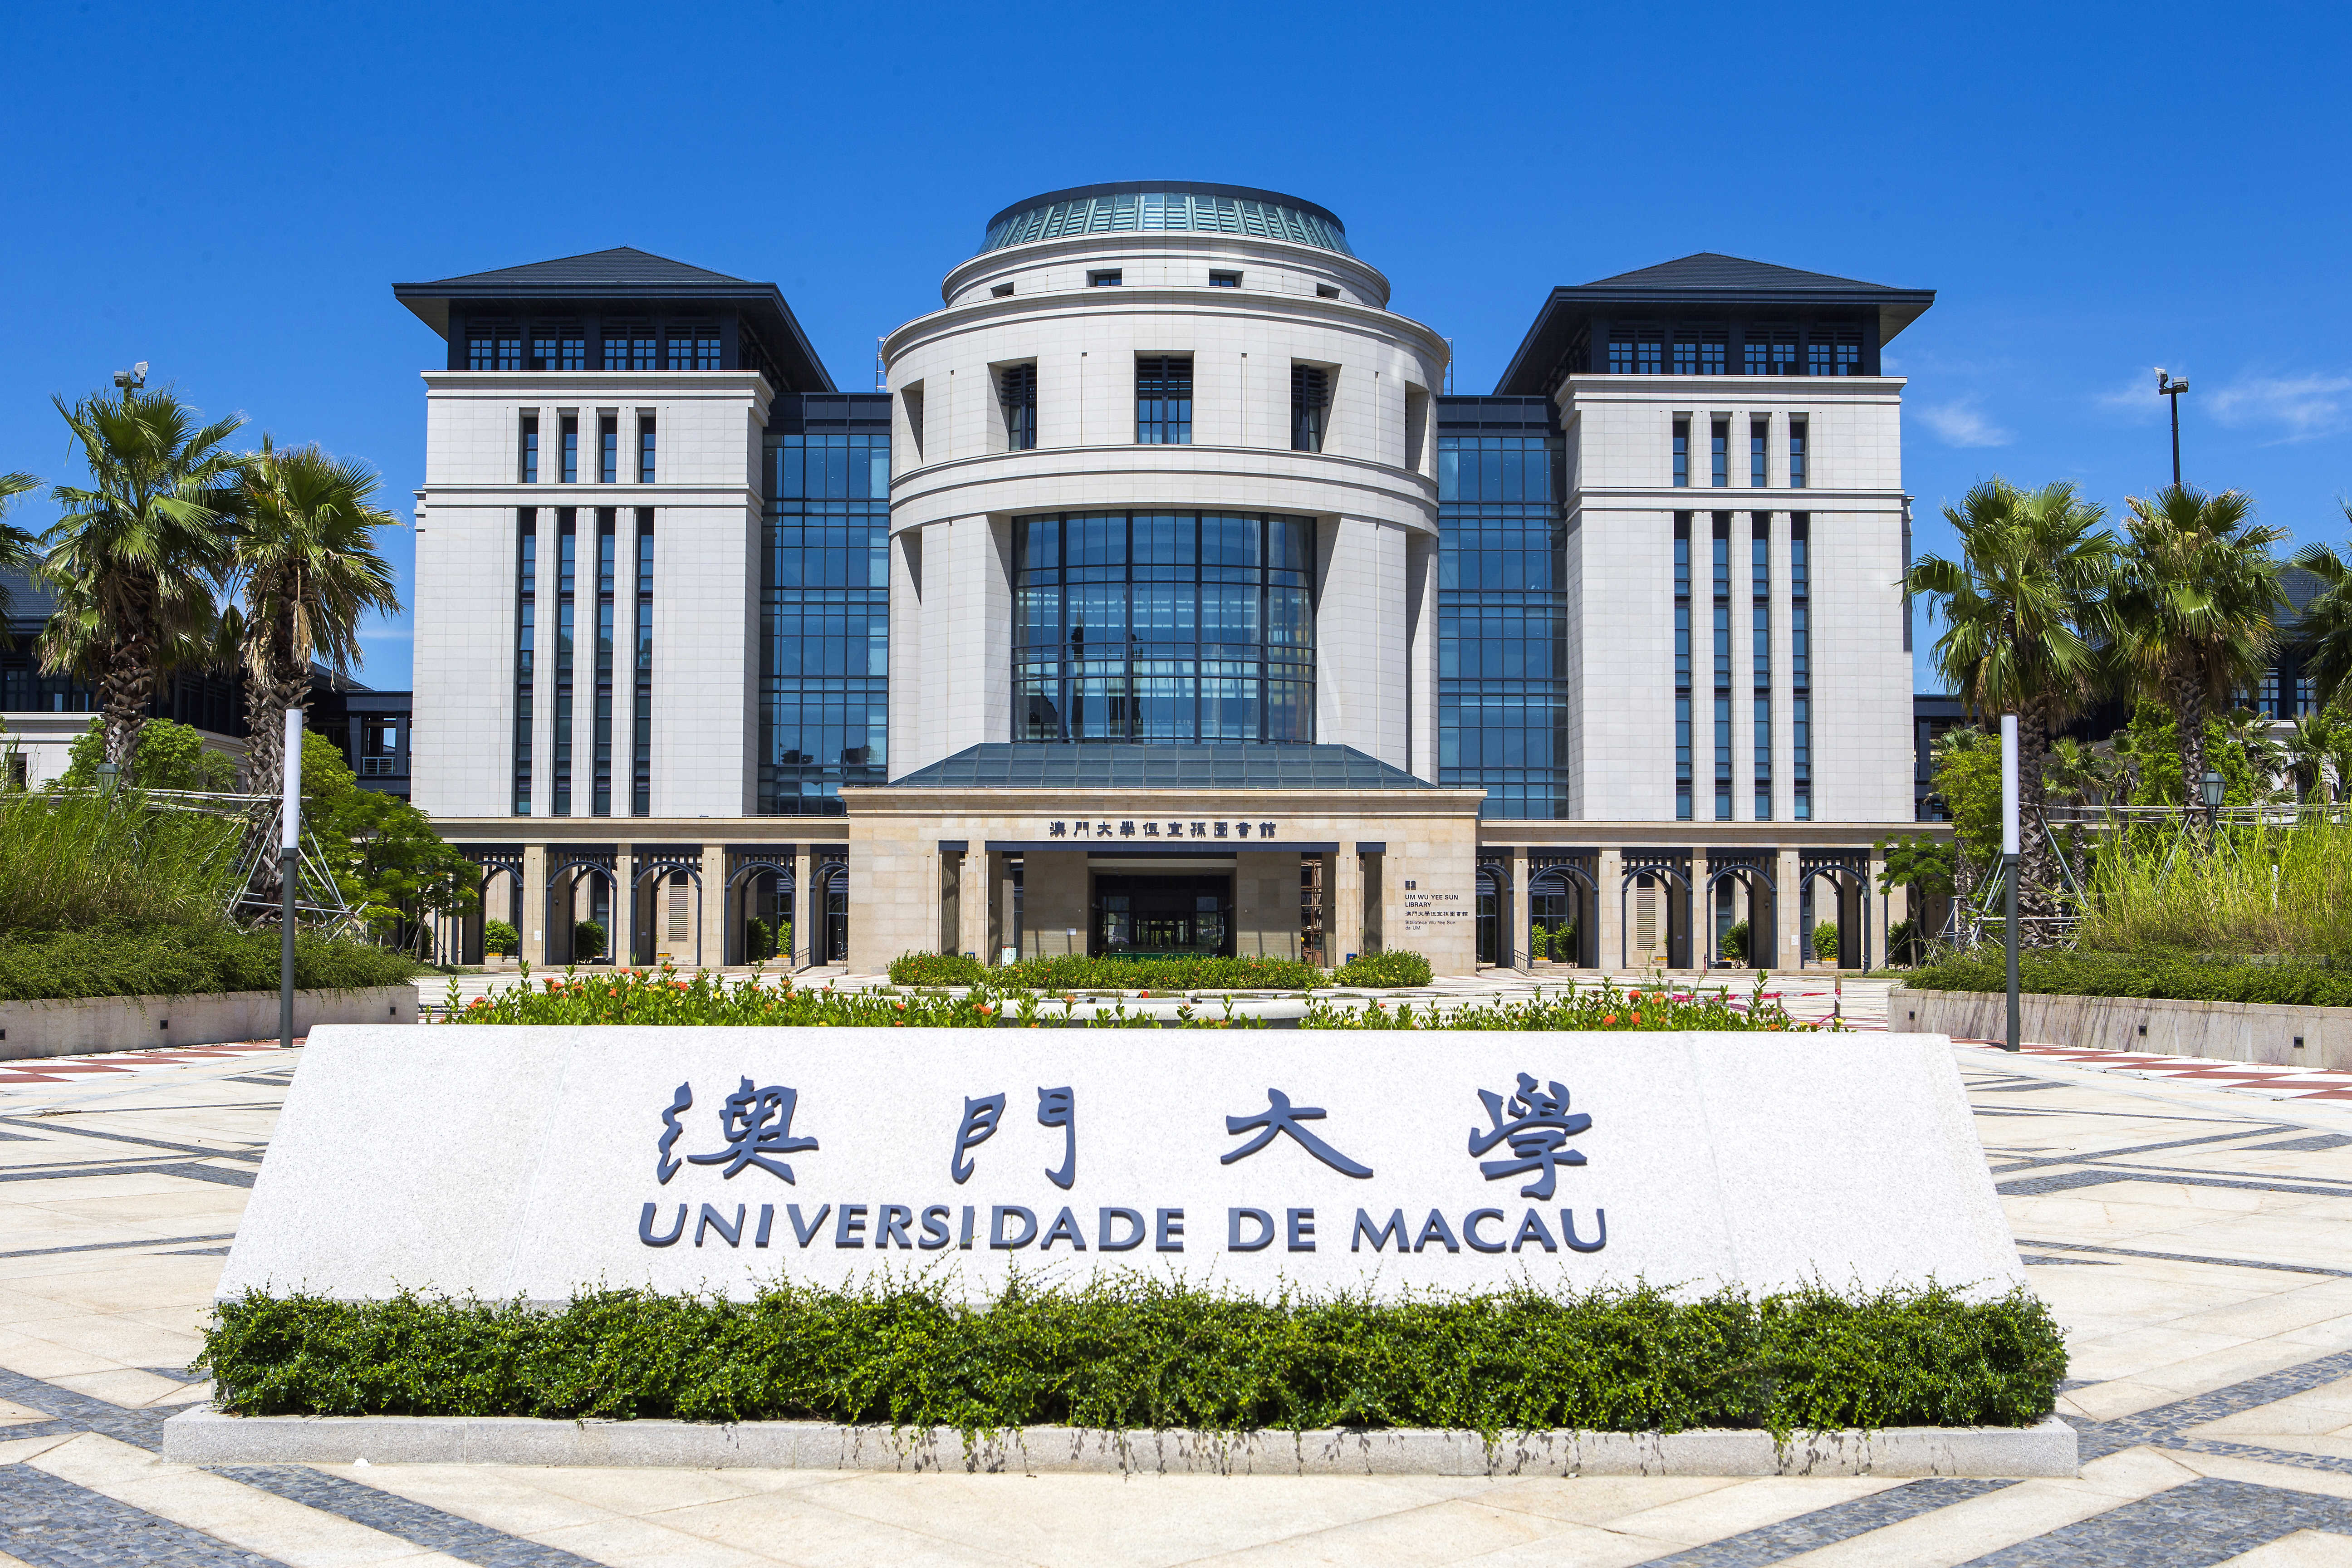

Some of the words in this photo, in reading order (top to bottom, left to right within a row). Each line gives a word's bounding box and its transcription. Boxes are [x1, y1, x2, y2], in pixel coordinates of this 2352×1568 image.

[1049, 820, 1277, 839] 澳門大學伍宜孫圖書館
[656, 1072, 1593, 1199] 澳門大學
[639, 1202, 1185, 1251] UNIVERSIDADE
[1227, 1207, 1317, 1251] DE
[1352, 1206, 1608, 1253] MACAU
